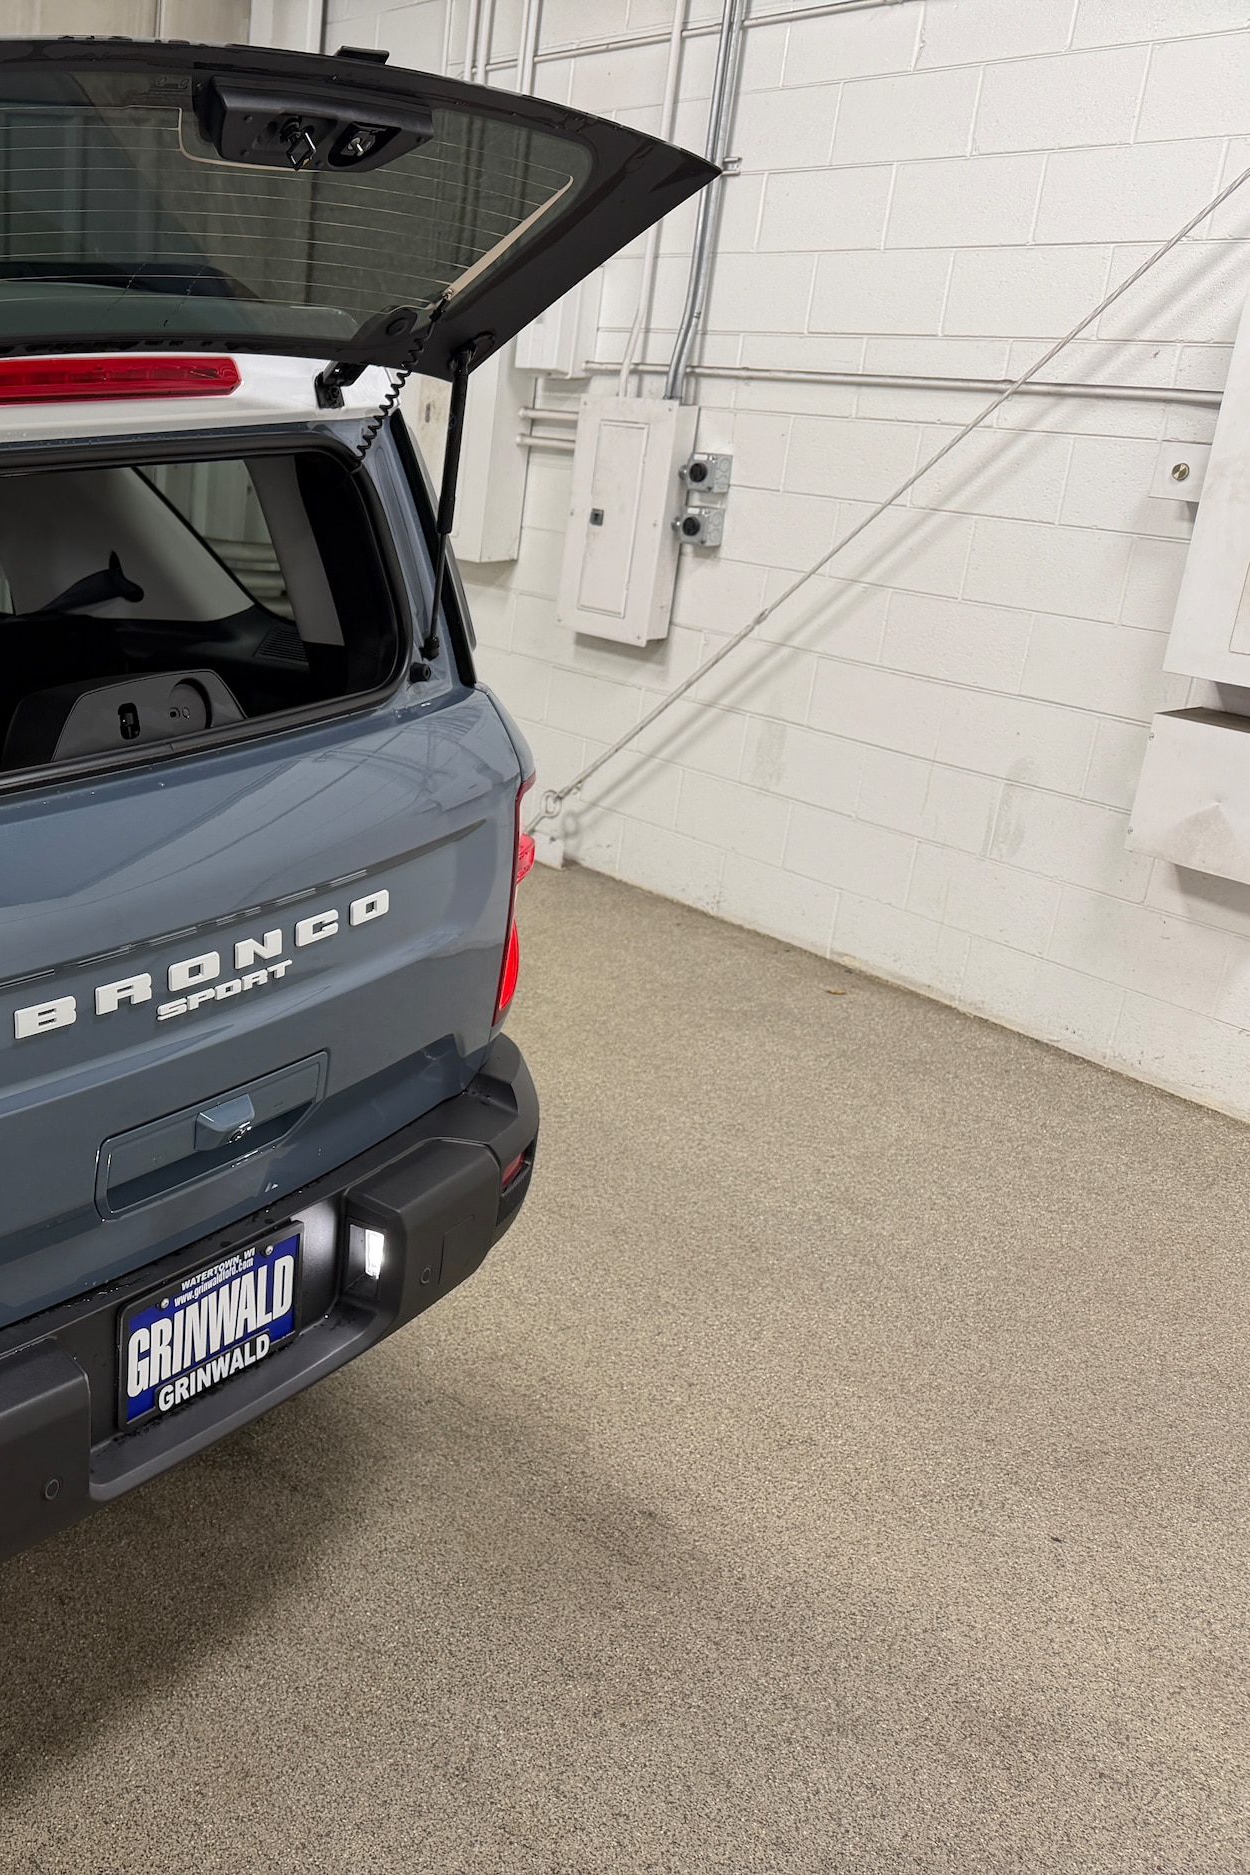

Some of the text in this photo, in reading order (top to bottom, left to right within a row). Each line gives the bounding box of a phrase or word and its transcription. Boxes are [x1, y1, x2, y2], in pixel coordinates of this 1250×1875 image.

[14, 888, 391, 1041] BRONCO
[156, 958, 293, 1022] SPORT
[174, 1257, 254, 1307] www.grinwaldford.com
[181, 1247, 256, 1291] WATERTOWN, WI
[127, 1254, 295, 1398] GRINWALD
[158, 1333, 271, 1412] GRINWALD
